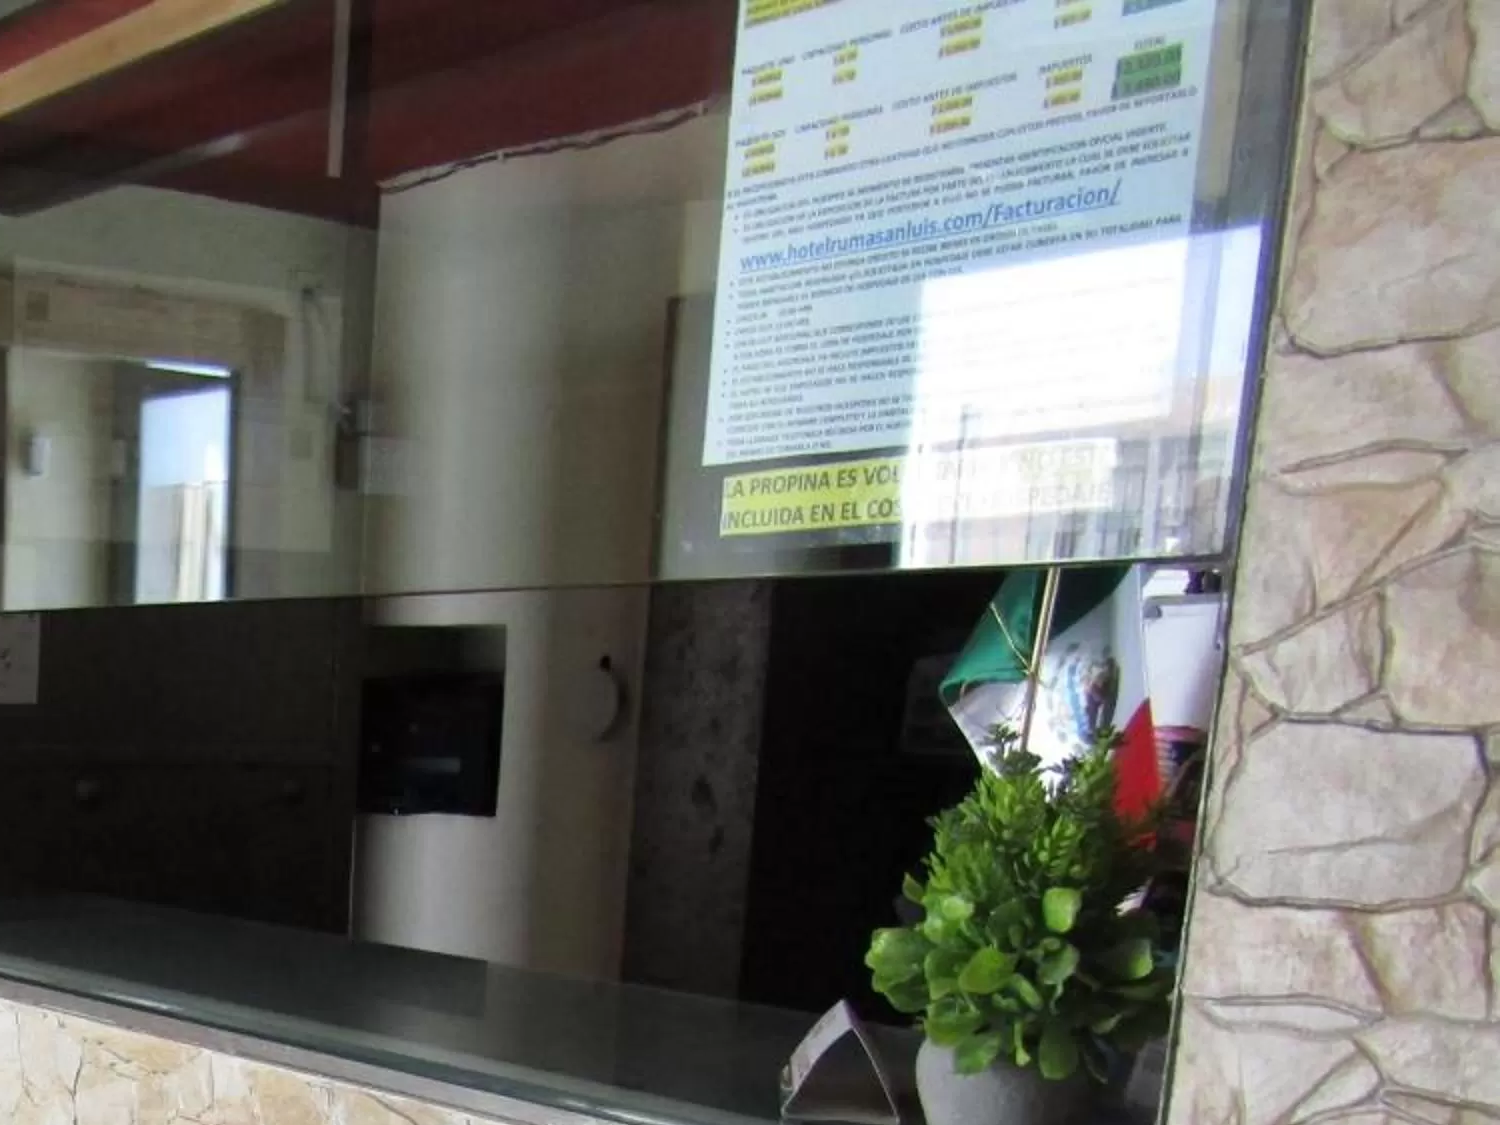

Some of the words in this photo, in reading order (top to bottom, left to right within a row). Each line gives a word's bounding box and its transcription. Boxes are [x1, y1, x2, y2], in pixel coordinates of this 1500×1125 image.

[727, 479, 745, 499] LA
[750, 470, 831, 496] PROPINA
[837, 469, 857, 488] ES
[722, 508, 804, 530] INCLUIDA
[810, 503, 835, 523] EN
[841, 501, 861, 519] EL
